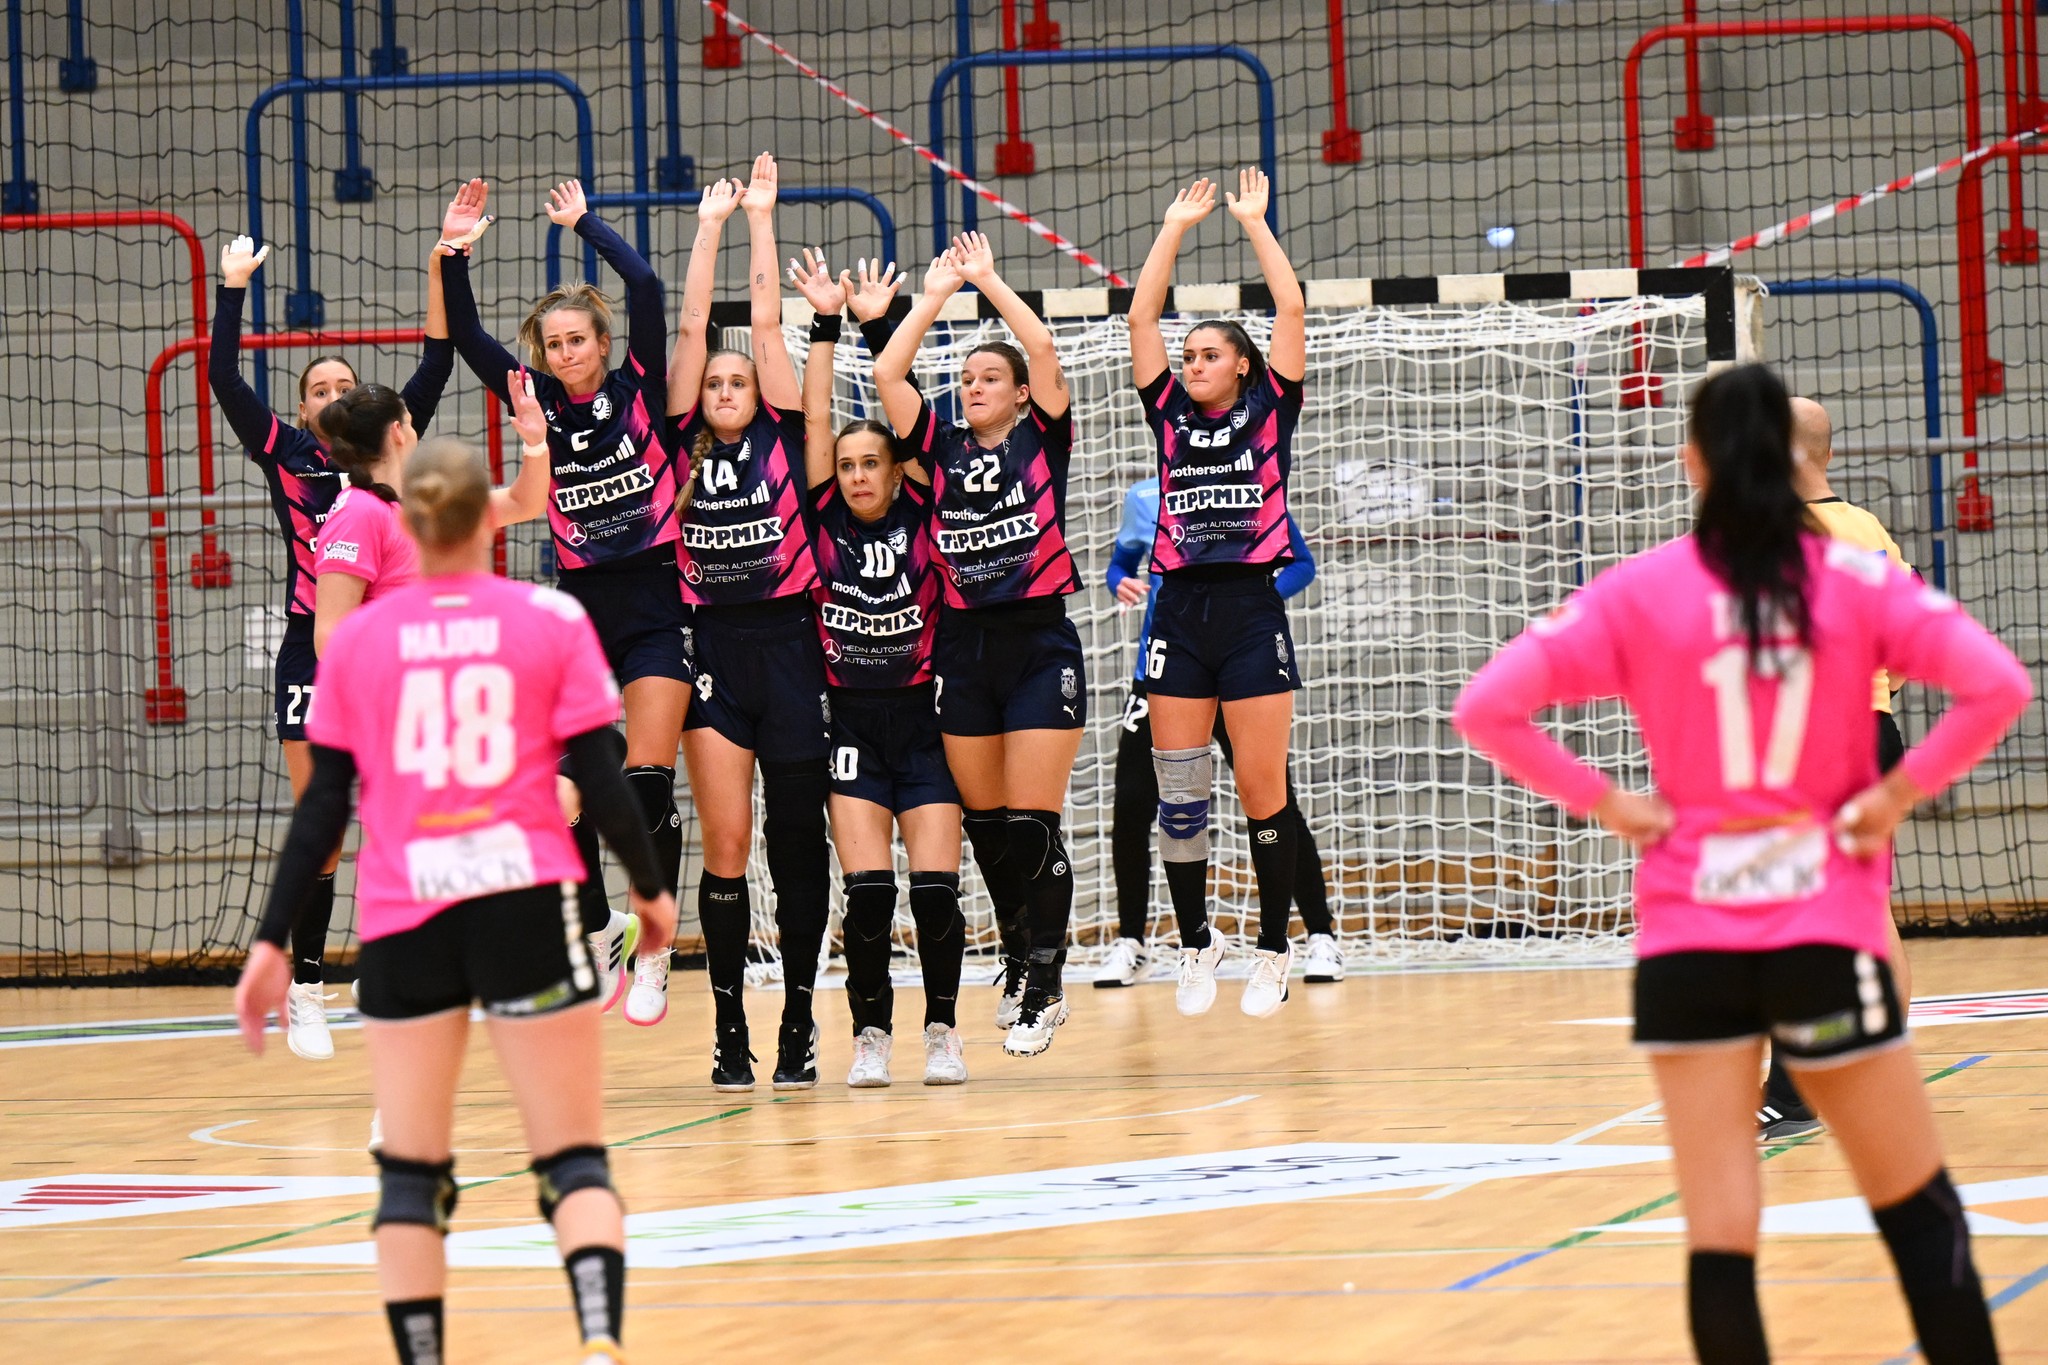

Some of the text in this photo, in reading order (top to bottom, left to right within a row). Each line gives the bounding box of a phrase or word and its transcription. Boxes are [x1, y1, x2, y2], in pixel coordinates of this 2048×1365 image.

[554, 455, 616, 476] motherson
[963, 454, 1001, 493] 22
[701, 459, 738, 495] 14
[691, 497, 749, 511] moherson
[941, 501, 1003, 521] mothern
[584, 500, 662, 530] HEDIN AUTOMOTIVE
[1209, 520, 1263, 528] AUTOMOTIVE
[590, 525, 630, 540] AUTENTIK
[1186, 533, 1226, 543] AUTENTIK
[731, 553, 787, 569] AUTOMOTIVE
[860, 541, 895, 578] 10
[960, 562, 986, 573] HEDIN
[705, 573, 750, 583] AUTENTIK
[963, 570, 1006, 584] AUTENTIK
[843, 657, 888, 666] AUTENTIK
[1123, 694, 1149, 733] 12
[1703, 646, 1814, 790] 17
[393, 664, 515, 789] 48
[709, 892, 738, 901] SELECT
